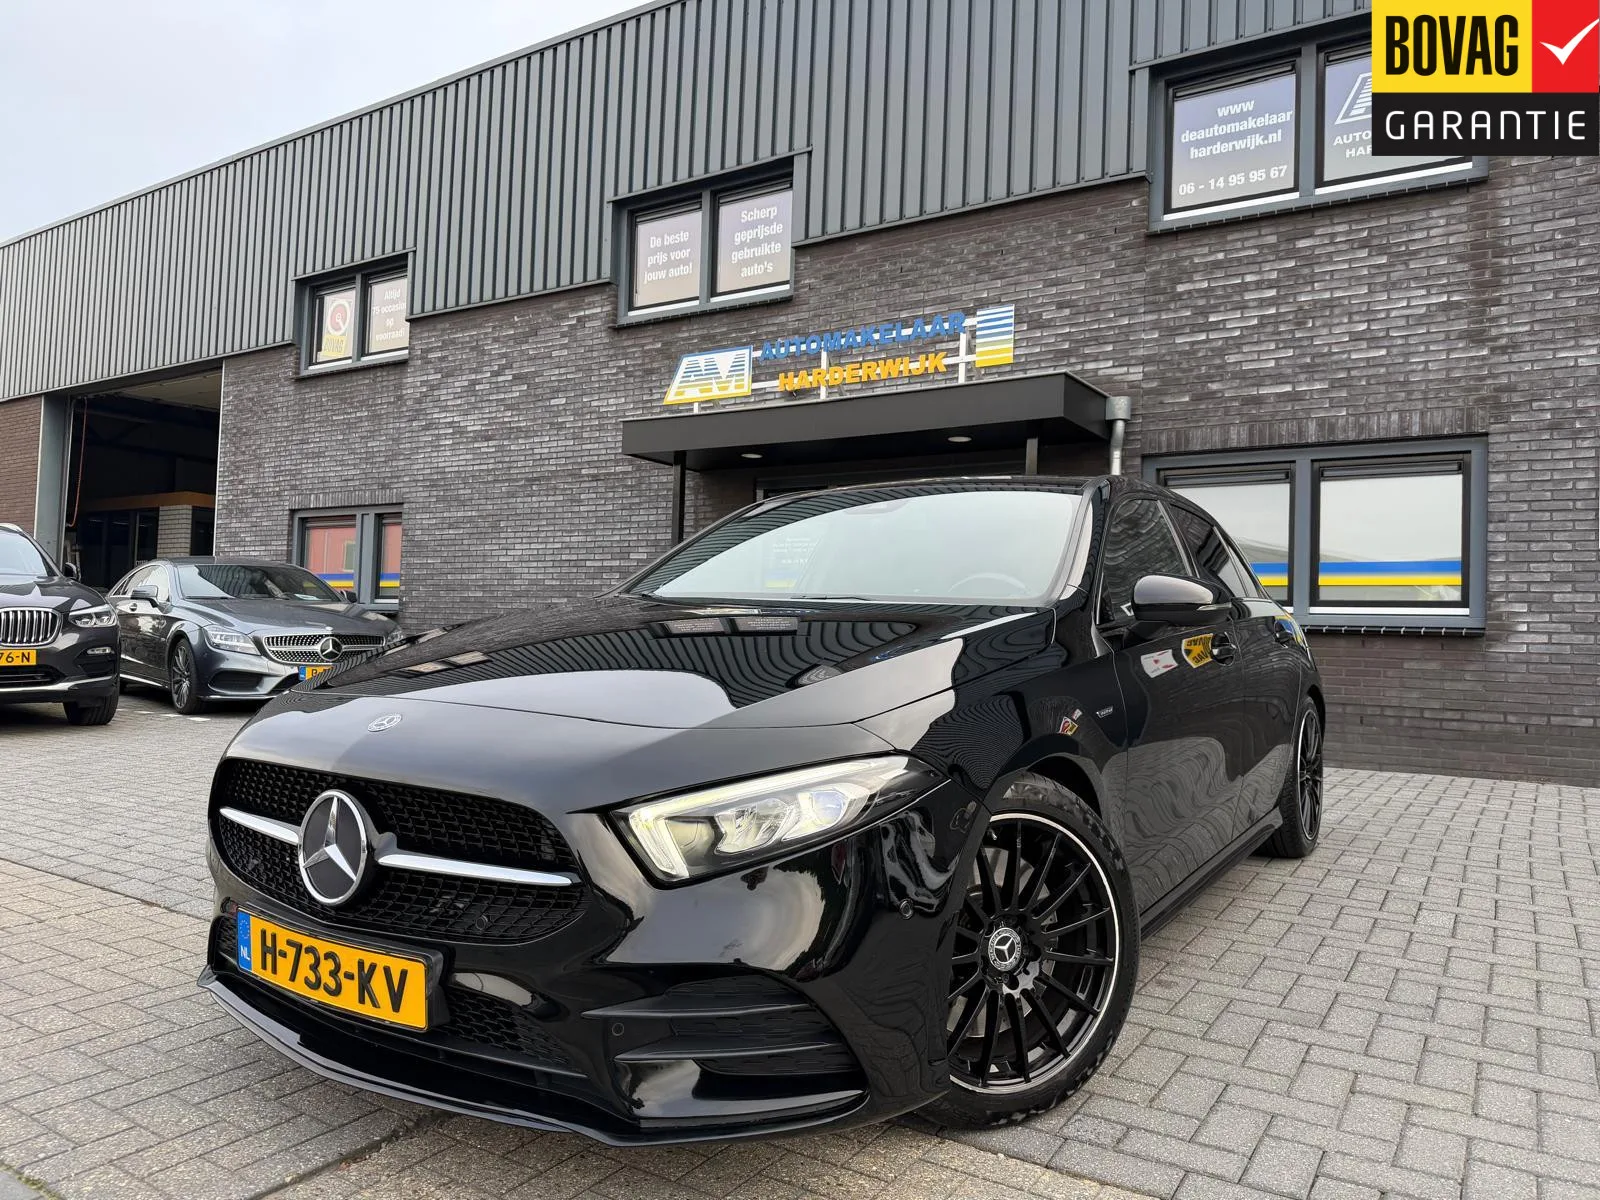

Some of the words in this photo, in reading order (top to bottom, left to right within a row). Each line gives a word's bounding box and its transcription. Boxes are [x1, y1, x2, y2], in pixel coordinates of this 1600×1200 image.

[1217, 100, 1255, 117] www
[1181, 110, 1293, 143] deautomakelaar
[1190, 129, 1282, 159] harderwijk.nl
[1333, 130, 1372, 146] AUTO
[1178, 182, 1195, 195] 06
[1209, 177, 1225, 190] 14
[1228, 172, 1245, 186] 95
[1249, 169, 1266, 182] 95
[1270, 165, 1288, 179] 67
[741, 205, 778, 223] Scherp
[650, 236, 662, 248] De
[664, 231, 689, 245] beste
[734, 223, 783, 245] geprijsde
[647, 253, 668, 267] prijs
[670, 248, 691, 261] voor
[731, 242, 782, 263] gebruikte
[644, 270, 667, 284] jouw
[668, 263, 693, 279] auto!
[741, 261, 774, 278] auto's
[759, 312, 966, 361] AUTOMAKELAAR
[778, 352, 948, 393] HARDERWIJK
[240, 945, 251, 961] NL
[260, 928, 408, 1013] H-733-KV
